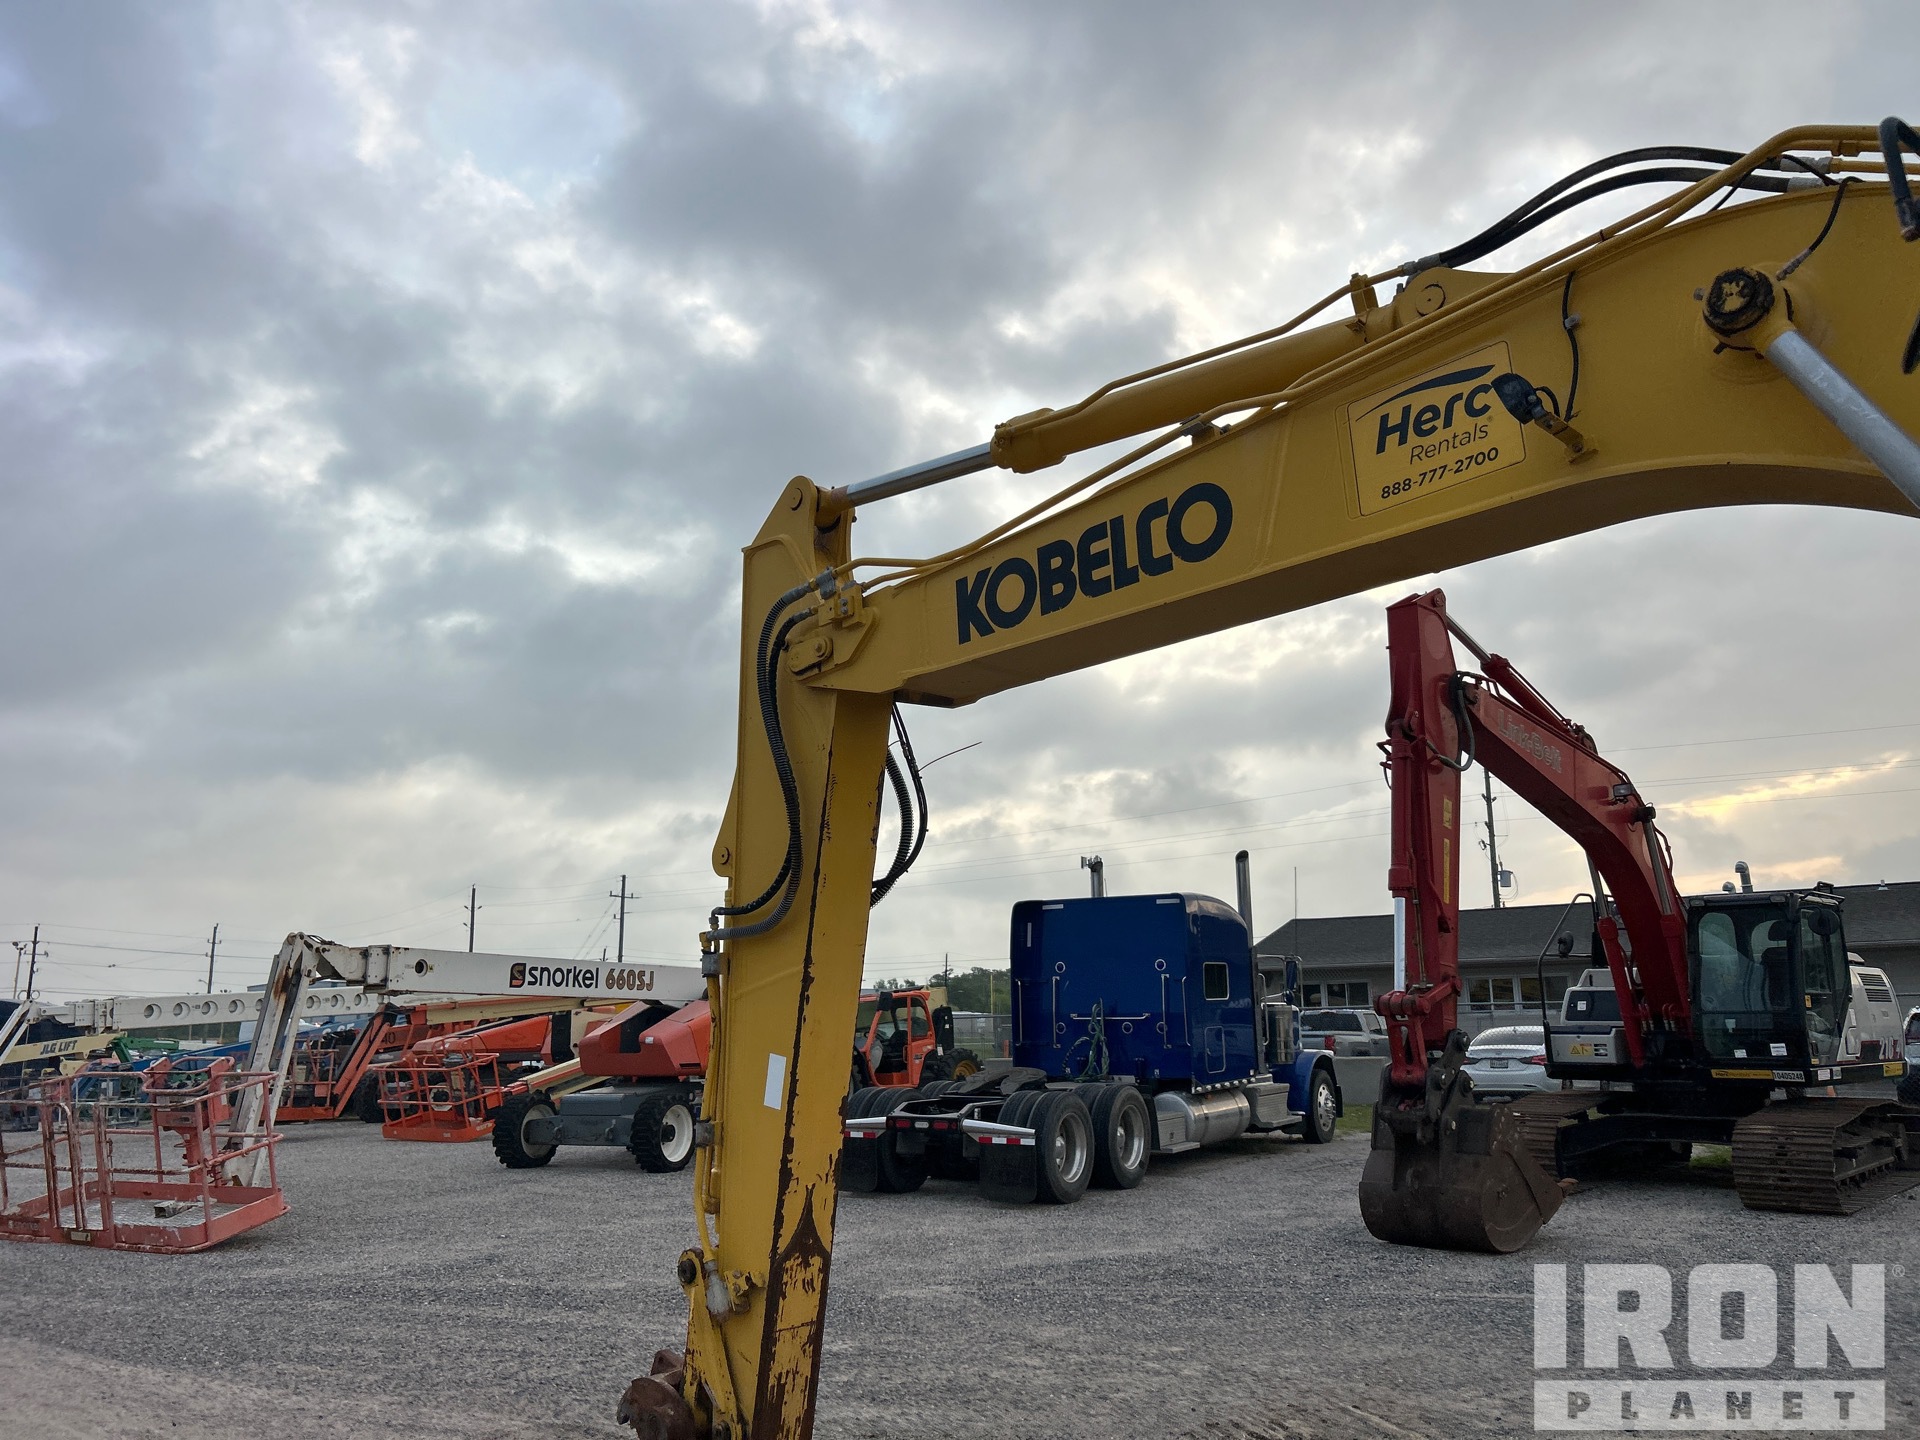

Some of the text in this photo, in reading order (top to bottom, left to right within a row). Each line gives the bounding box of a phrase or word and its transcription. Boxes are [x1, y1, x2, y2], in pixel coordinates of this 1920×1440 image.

[1376, 384, 1492, 455] Herc
[1409, 423, 1489, 465] Rentals
[1381, 447, 1499, 499] 888-777-2700
[955, 482, 1233, 645] KOBELCO
[1498, 709, 1562, 773] Link-Belt
[528, 966, 655, 991] snorkel 660SJ
[40, 1040, 77, 1055] JLG LIFT
